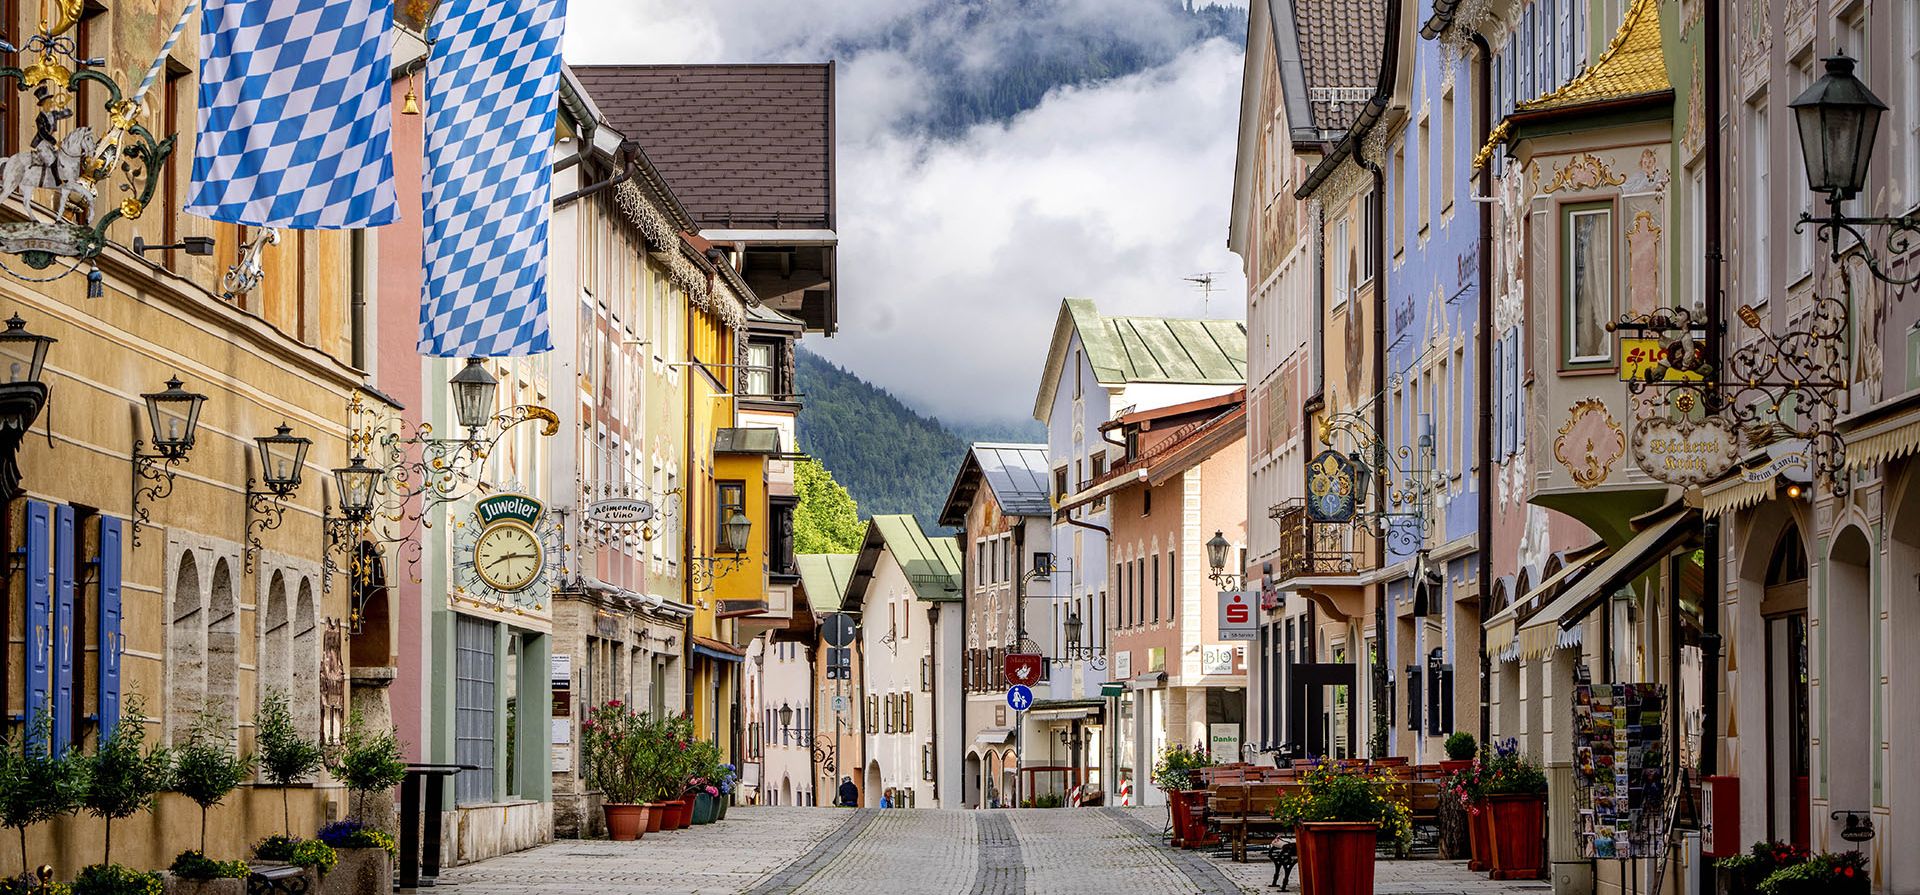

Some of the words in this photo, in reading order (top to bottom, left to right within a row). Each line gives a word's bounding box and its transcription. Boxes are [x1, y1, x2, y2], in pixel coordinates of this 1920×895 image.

[1650, 438, 1719, 454] Bäckerei
[1749, 470, 1772, 481] Beim
[480, 498, 538, 521] Juwelier
[594, 504, 646, 515] Alimentari
